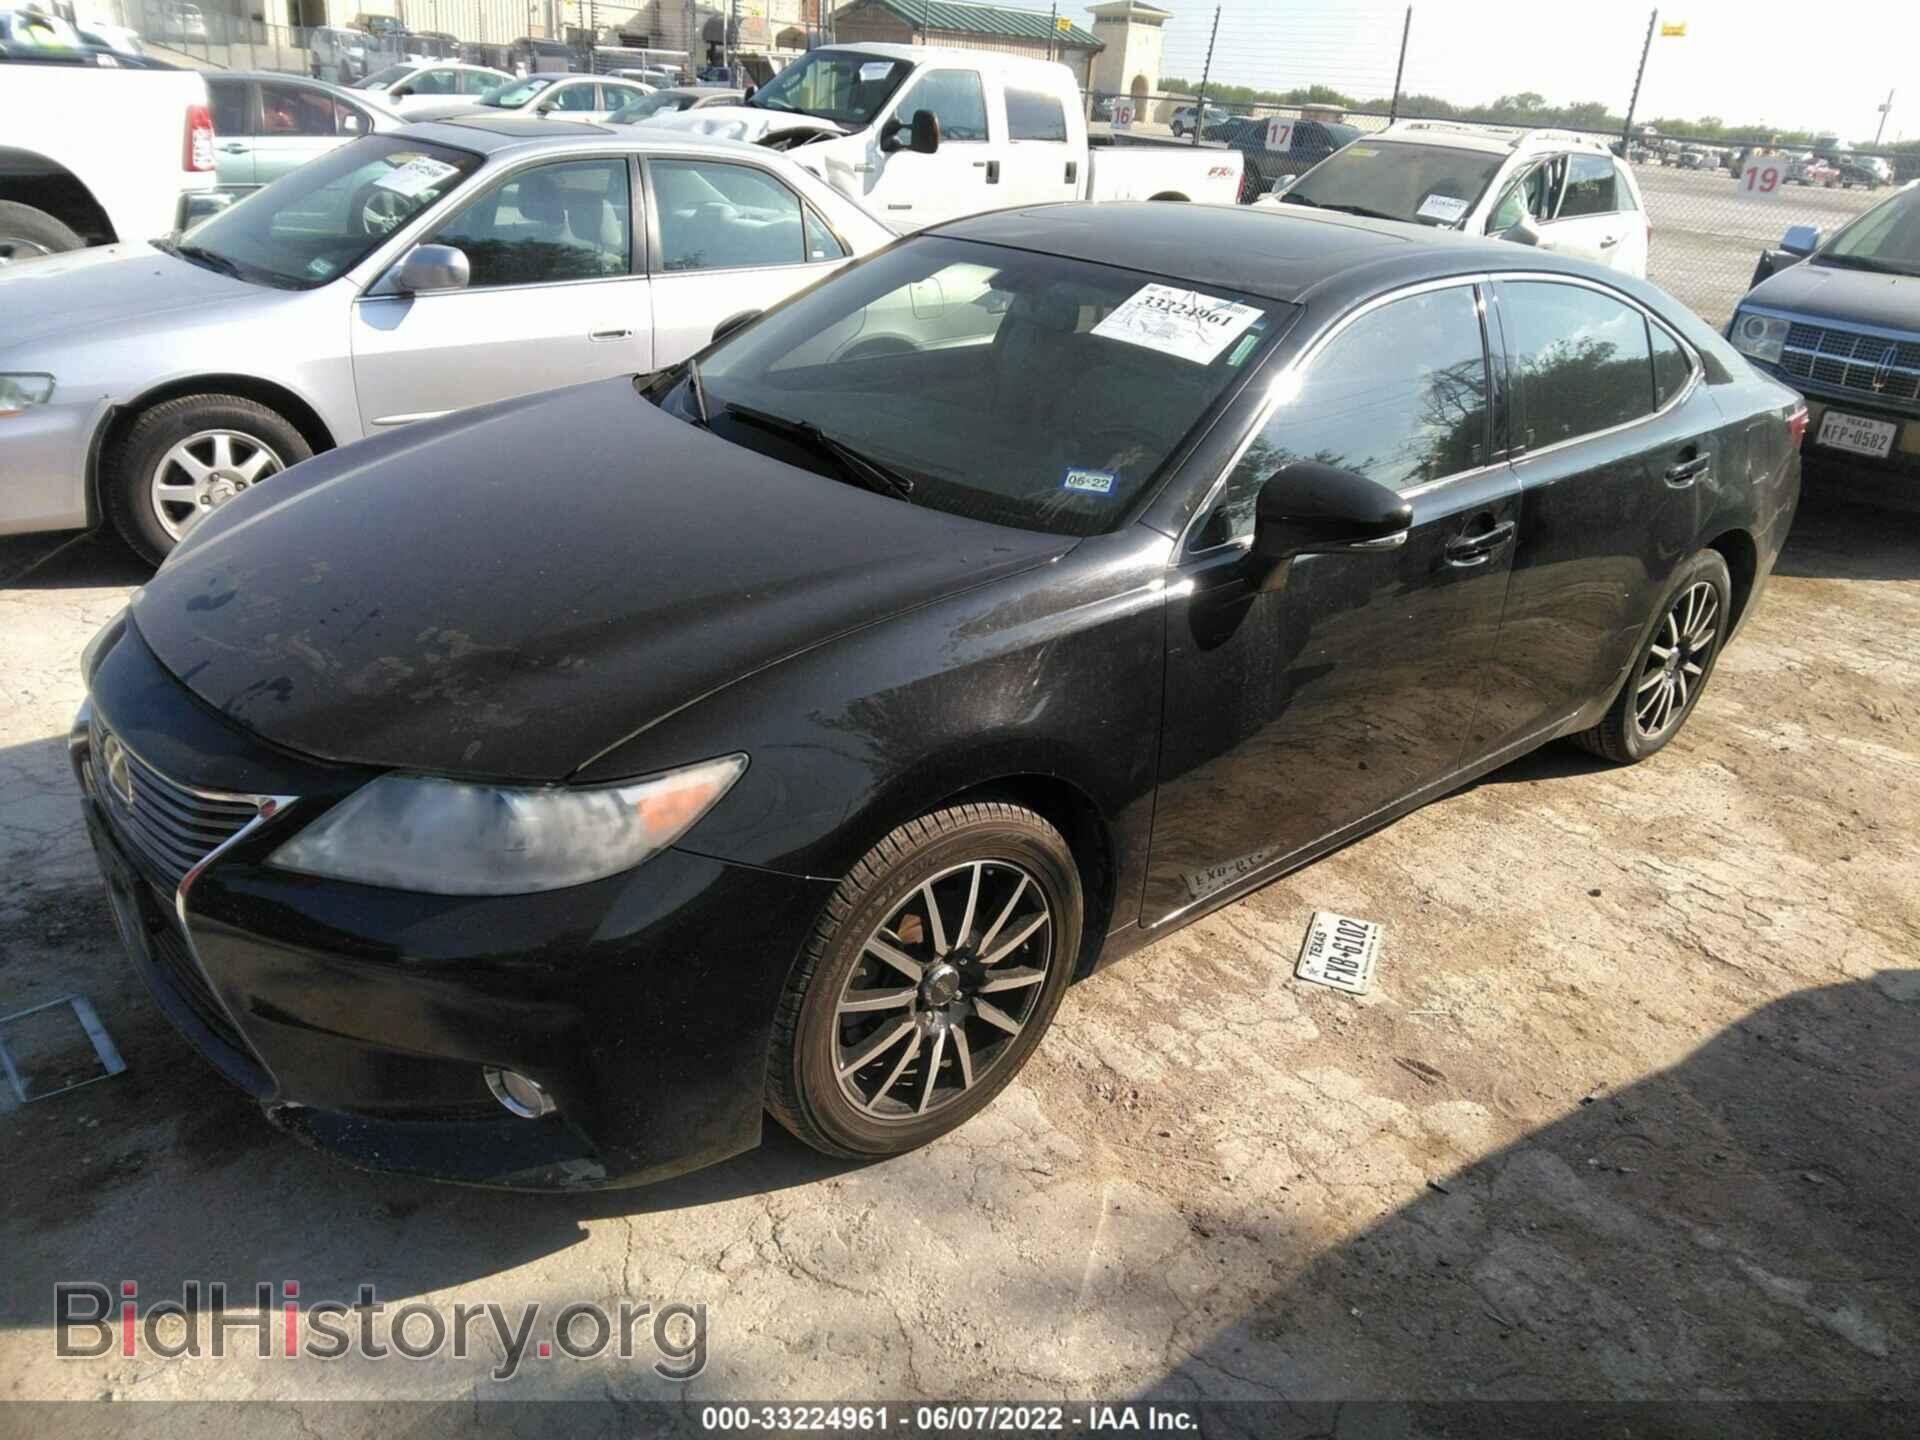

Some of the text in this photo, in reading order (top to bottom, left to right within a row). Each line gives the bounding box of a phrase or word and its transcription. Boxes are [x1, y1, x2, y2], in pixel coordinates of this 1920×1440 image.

[1114, 106, 1130, 124] 16
[1270, 124, 1291, 145] 17
[1746, 166, 1778, 192] 19
[1138, 295, 1233, 326] 33224961
[1308, 930, 1328, 958] TEXAS
